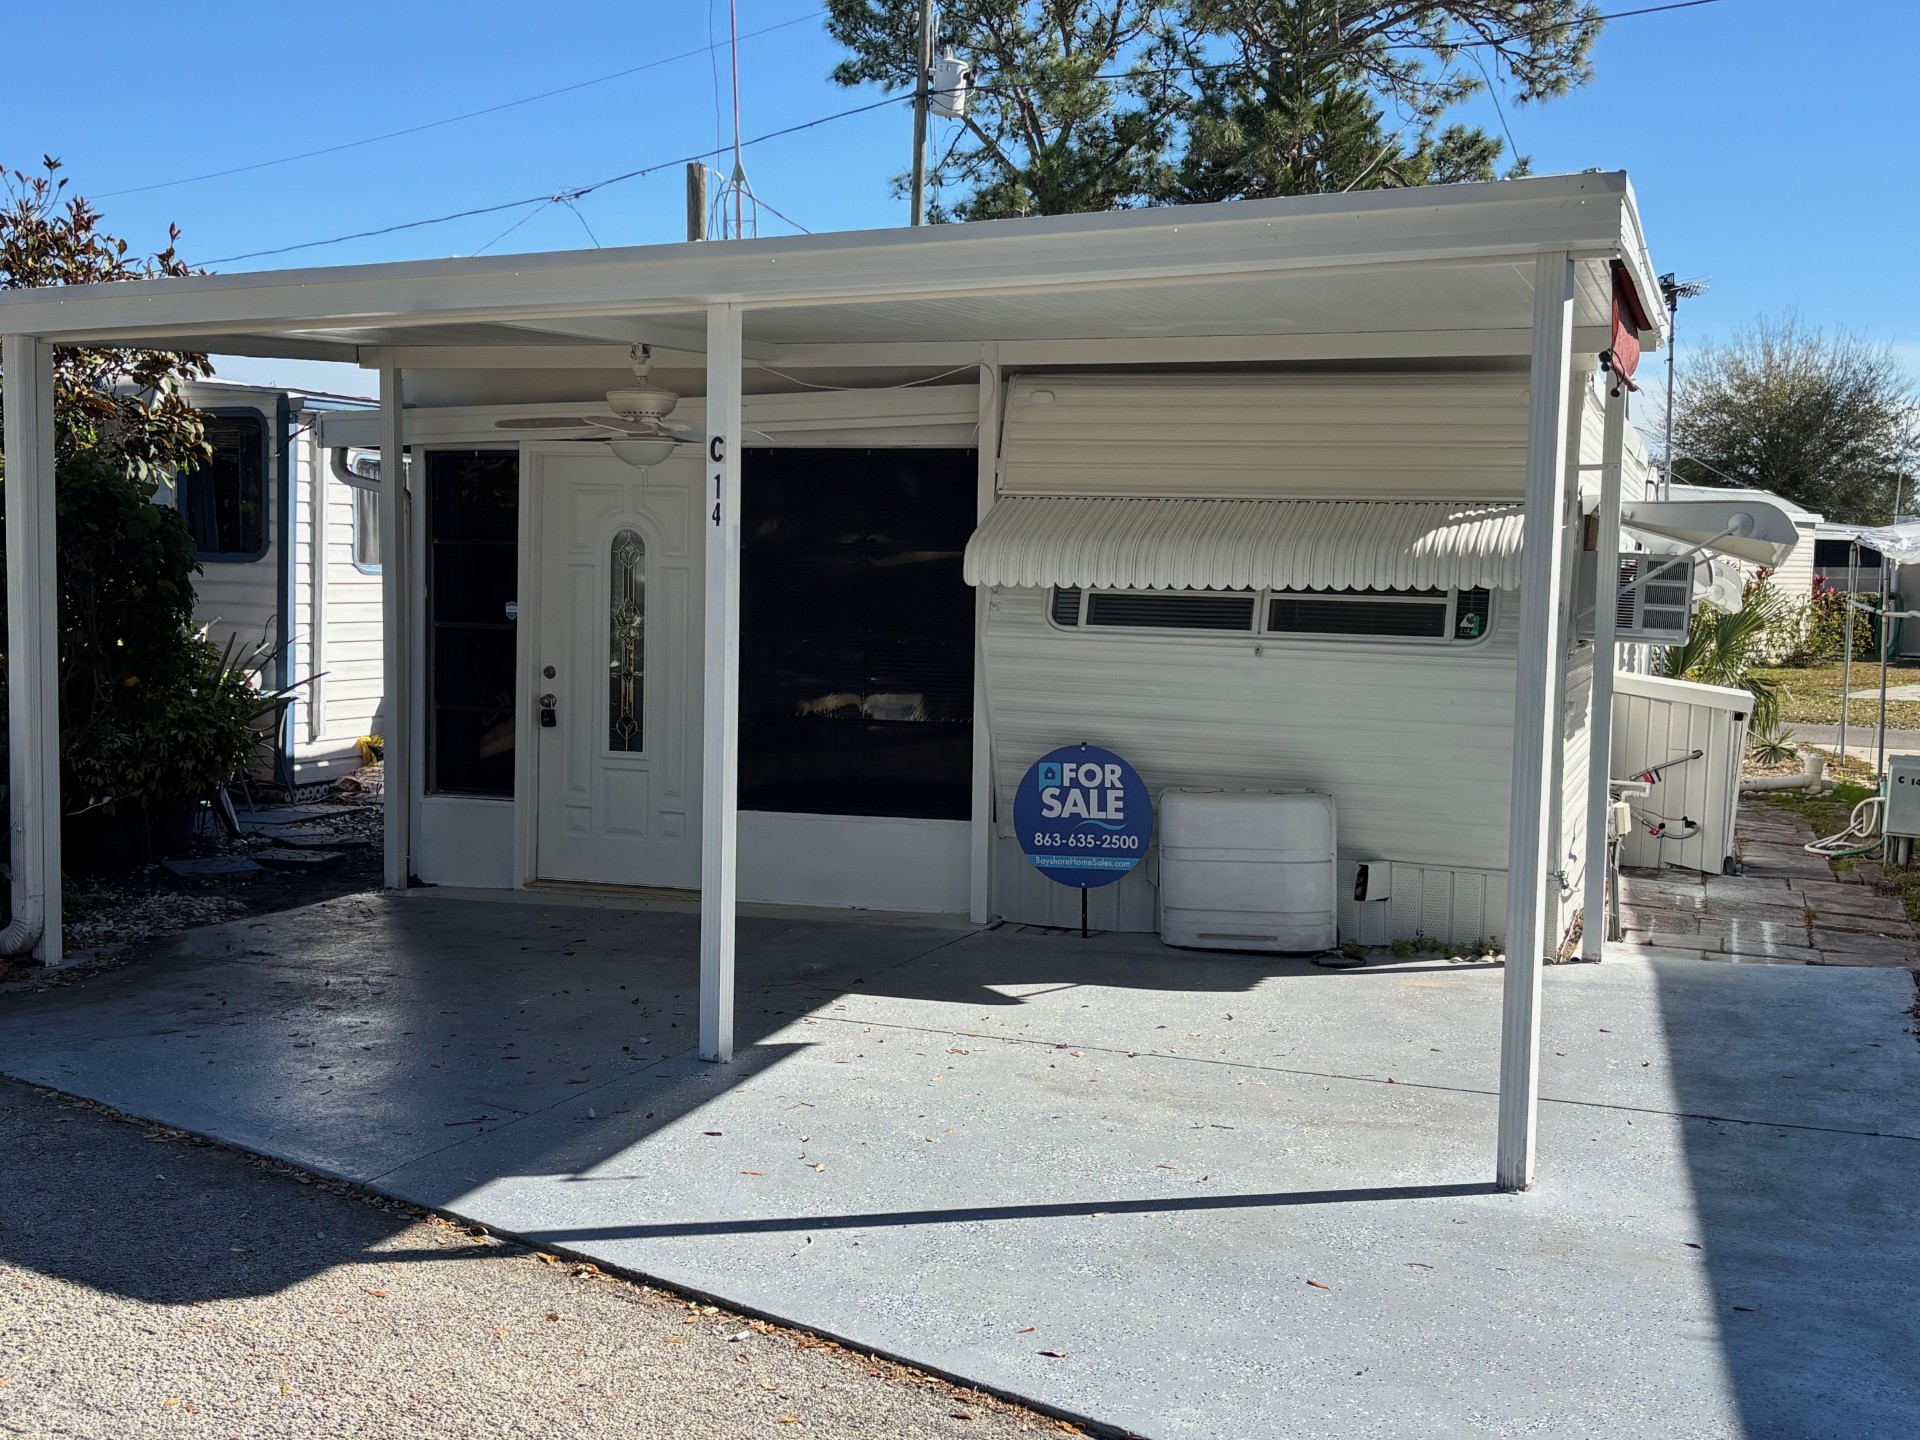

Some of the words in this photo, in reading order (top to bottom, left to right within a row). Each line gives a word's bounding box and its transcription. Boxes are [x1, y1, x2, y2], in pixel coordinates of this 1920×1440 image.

[1063, 762, 1124, 788] FOR
[1898, 775, 1905, 784] C
[1041, 787, 1124, 820] SALE
[1034, 832, 1139, 849] 863-635-2500
[1035, 856, 1131, 868] BayshoreHomeSales.com
